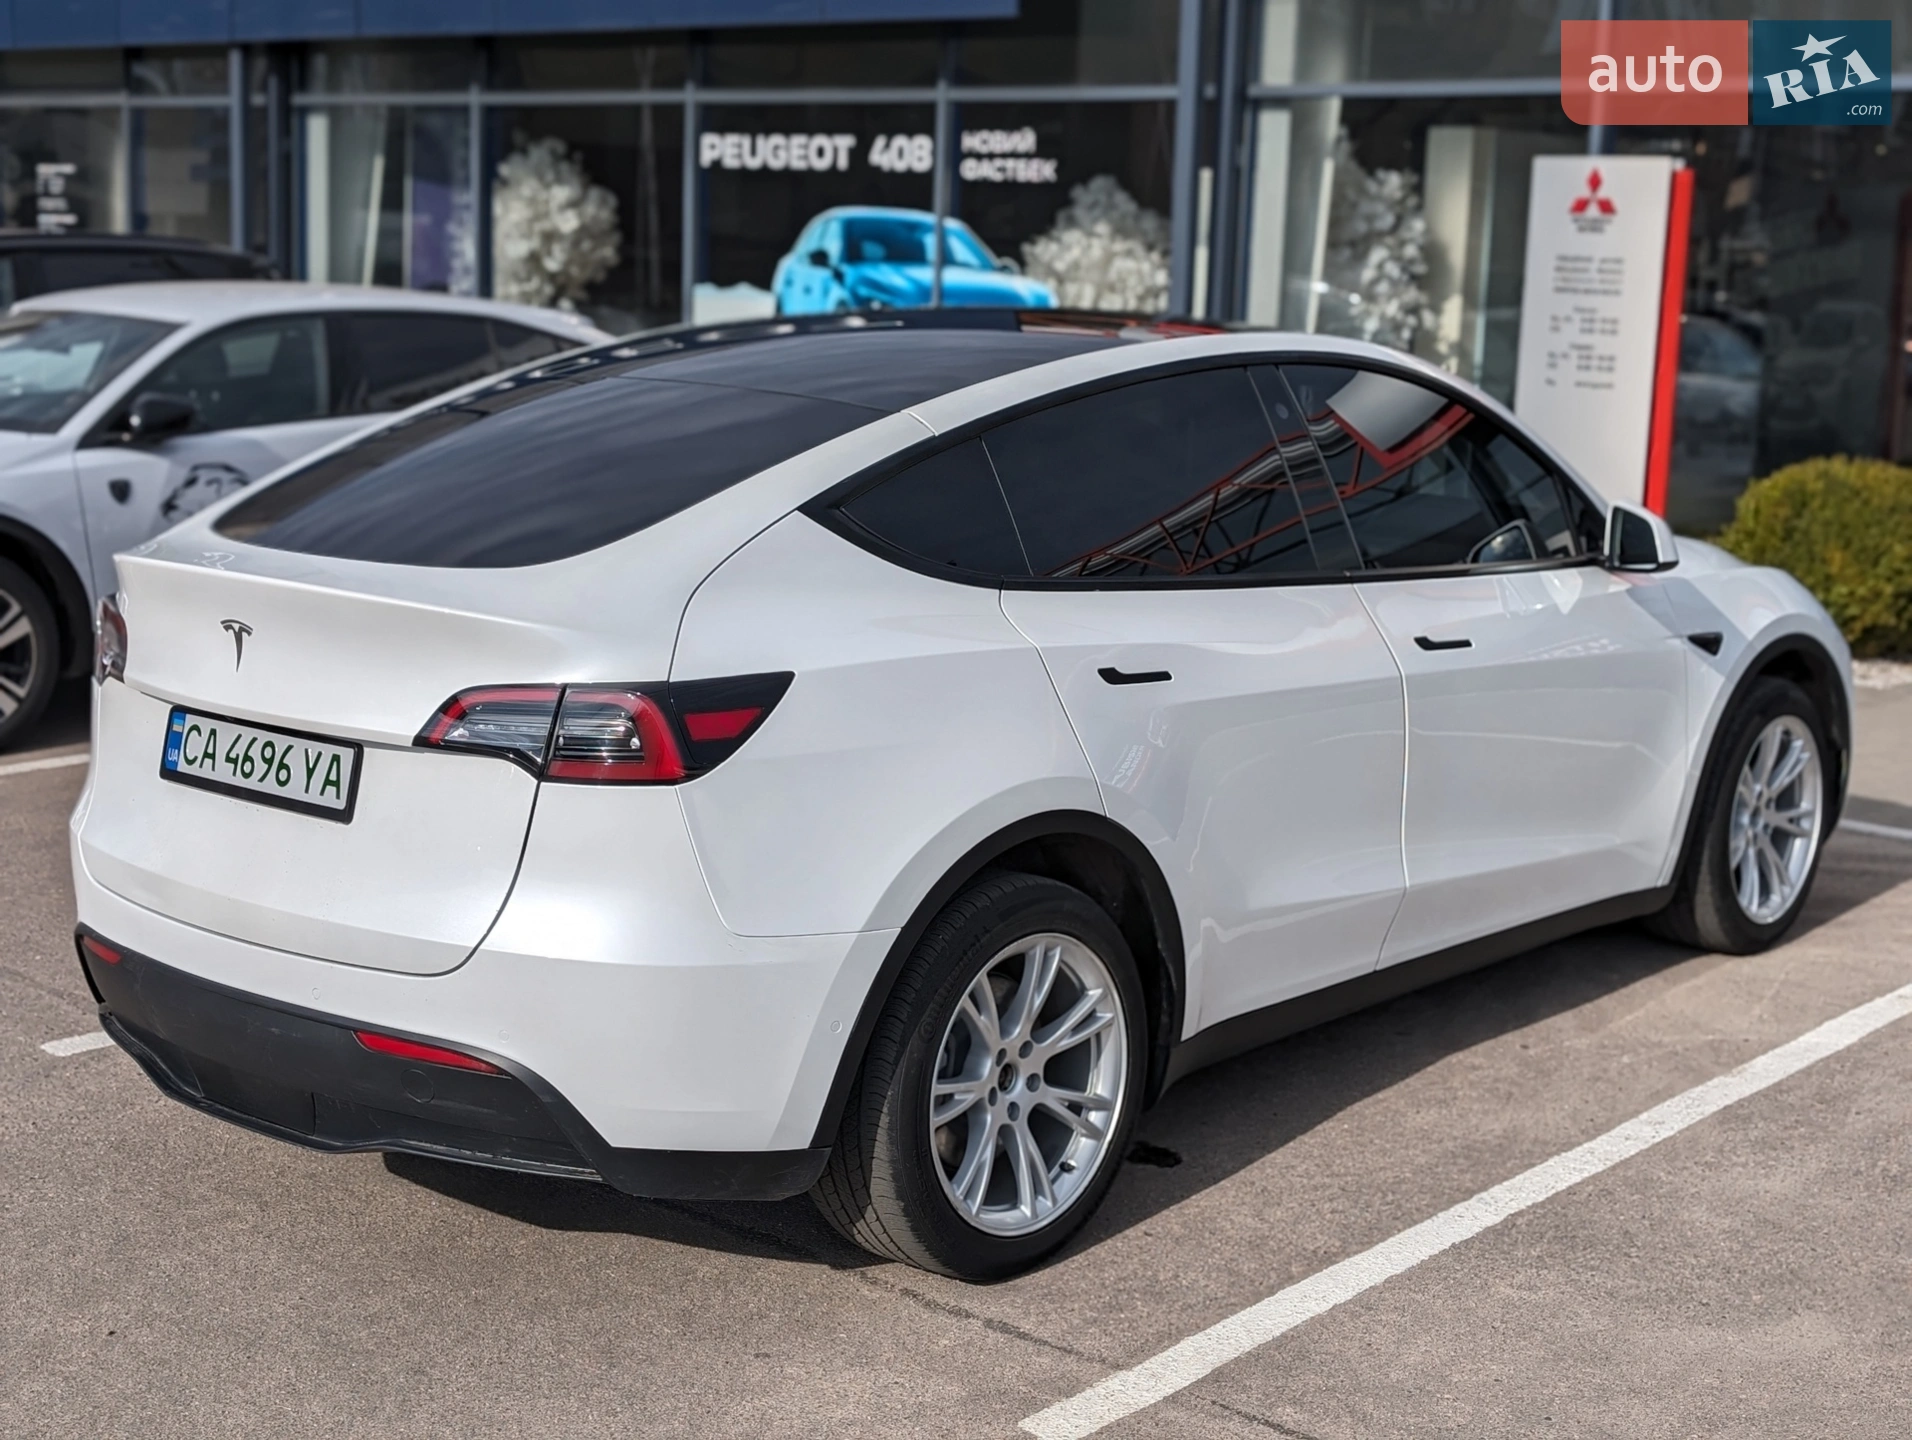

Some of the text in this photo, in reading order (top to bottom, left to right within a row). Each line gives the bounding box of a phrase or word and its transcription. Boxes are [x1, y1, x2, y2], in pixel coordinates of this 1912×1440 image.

[699, 132, 934, 173] PEUGEOT 408
[961, 126, 1037, 154] НОВИЙ
[959, 156, 1058, 183] ФАСТБЕК
[168, 747, 179, 763] UA
[183, 723, 342, 800] CA 4696 YA
